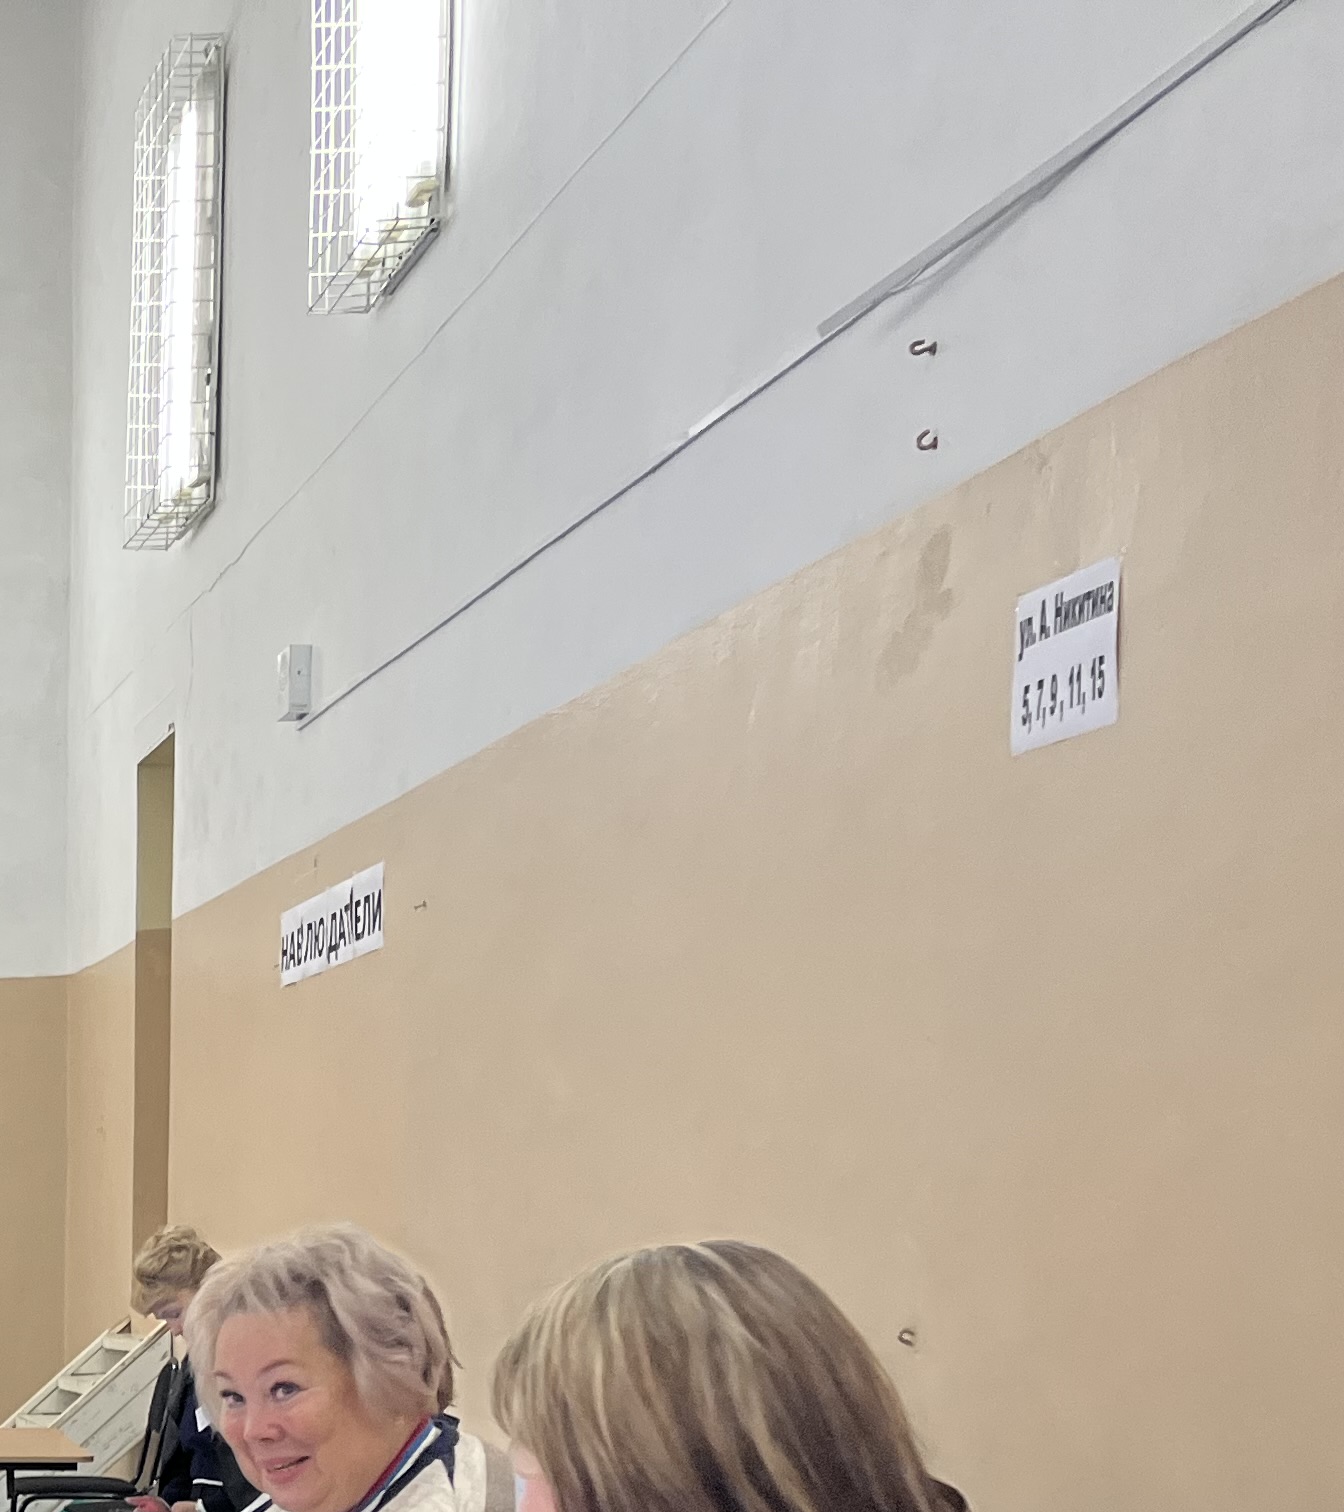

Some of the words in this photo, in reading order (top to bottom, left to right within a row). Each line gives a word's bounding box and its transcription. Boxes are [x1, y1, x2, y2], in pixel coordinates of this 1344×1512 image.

[1018, 616, 1037, 662] ул.
[1038, 598, 1051, 642] А.
[1053, 580, 1114, 636] Никитина
[1090, 654, 1105, 701] 15
